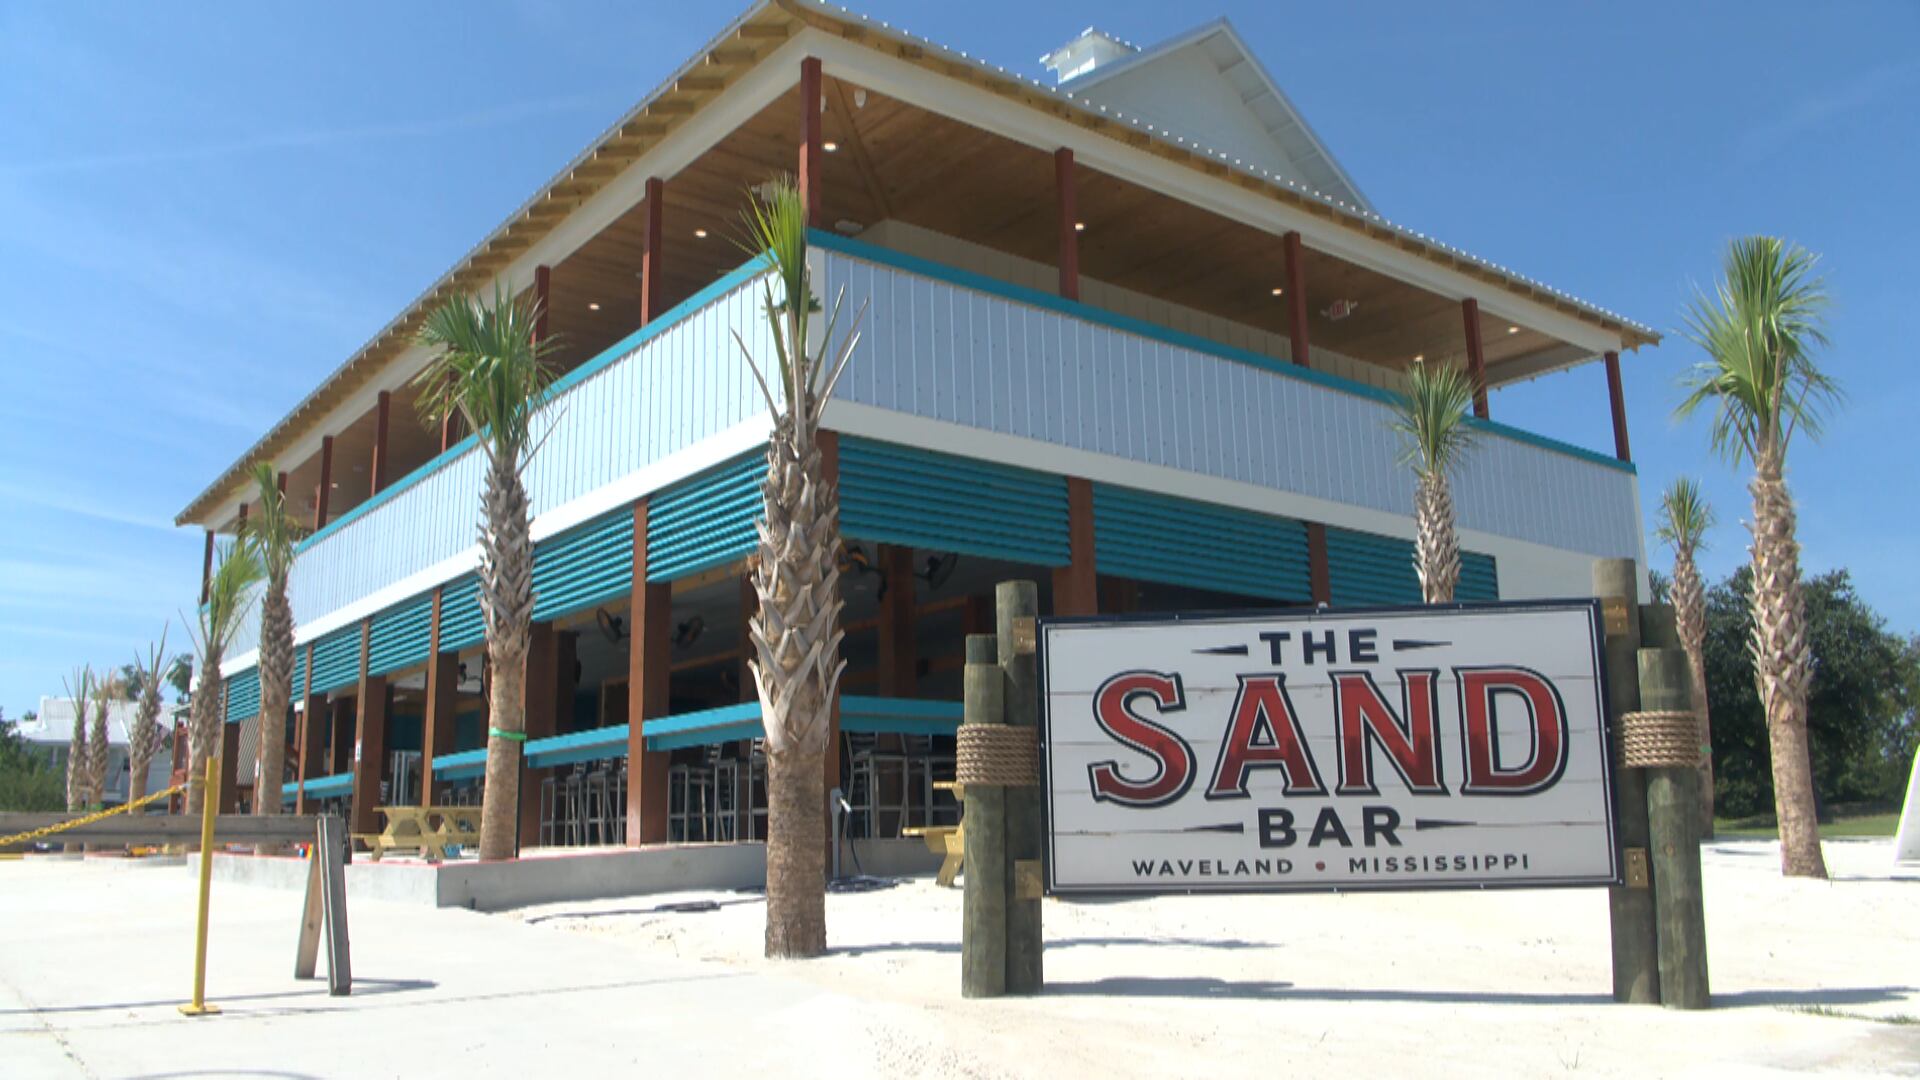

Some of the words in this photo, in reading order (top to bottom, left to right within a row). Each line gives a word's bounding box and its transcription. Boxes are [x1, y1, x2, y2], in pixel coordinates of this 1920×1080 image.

[1260, 629, 1380, 665] THE
[1087, 665, 1569, 808] SAND
[1259, 807, 1403, 848] BAR
[1132, 858, 1294, 876] WAVELAND
[1349, 853, 1530, 873] MISSISSIPPI
